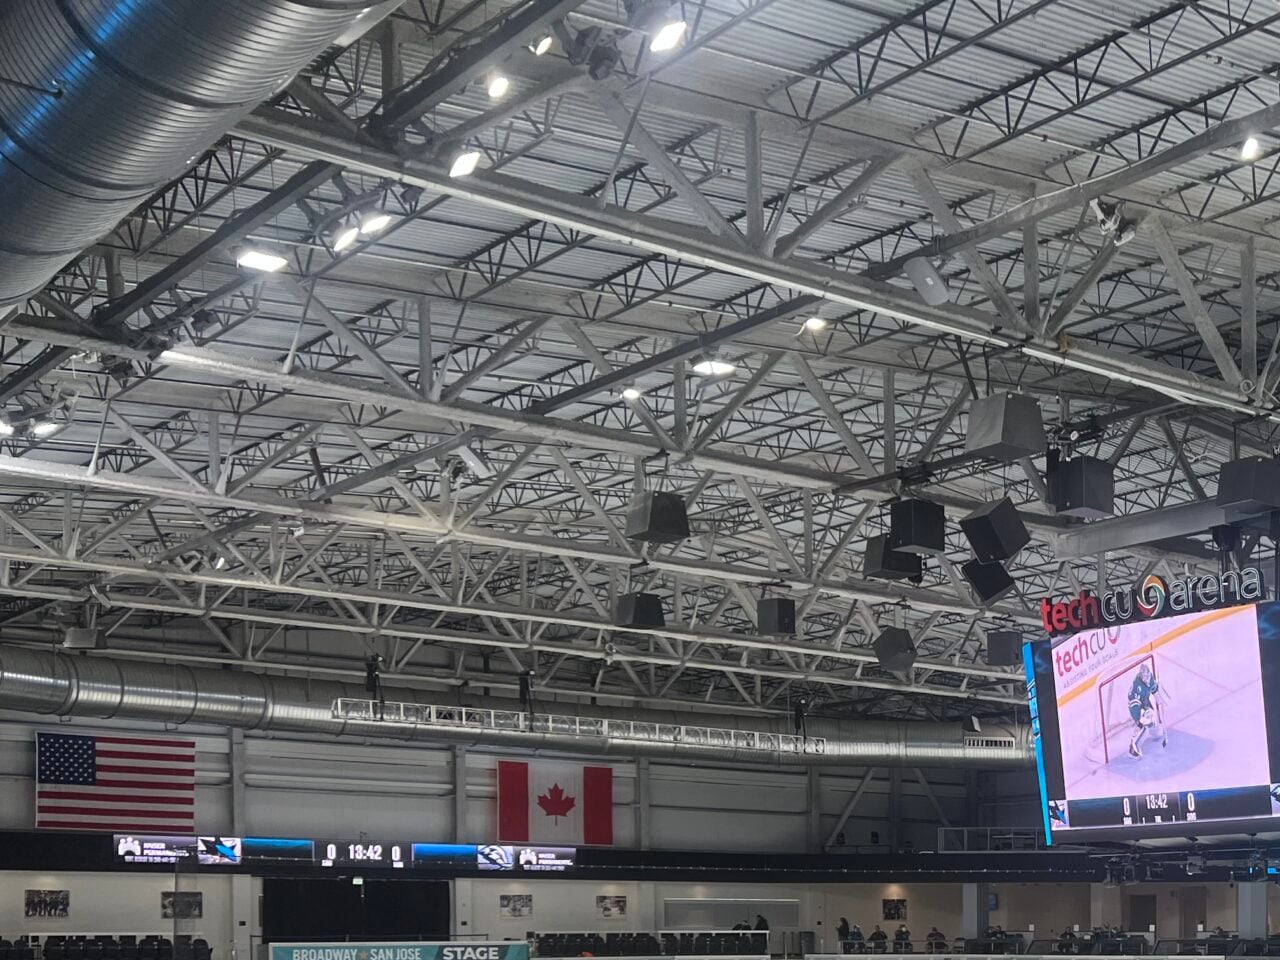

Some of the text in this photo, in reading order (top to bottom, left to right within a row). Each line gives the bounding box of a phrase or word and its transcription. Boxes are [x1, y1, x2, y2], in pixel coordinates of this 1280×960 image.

[1169, 567, 1264, 611] arena
[1146, 795, 1168, 809] 13:42
[326, 843, 400, 861] 0 13:42 0
[370, 948, 394, 960] SAN
[395, 948, 421, 960] JOSE
[442, 946, 500, 960] STAGE
